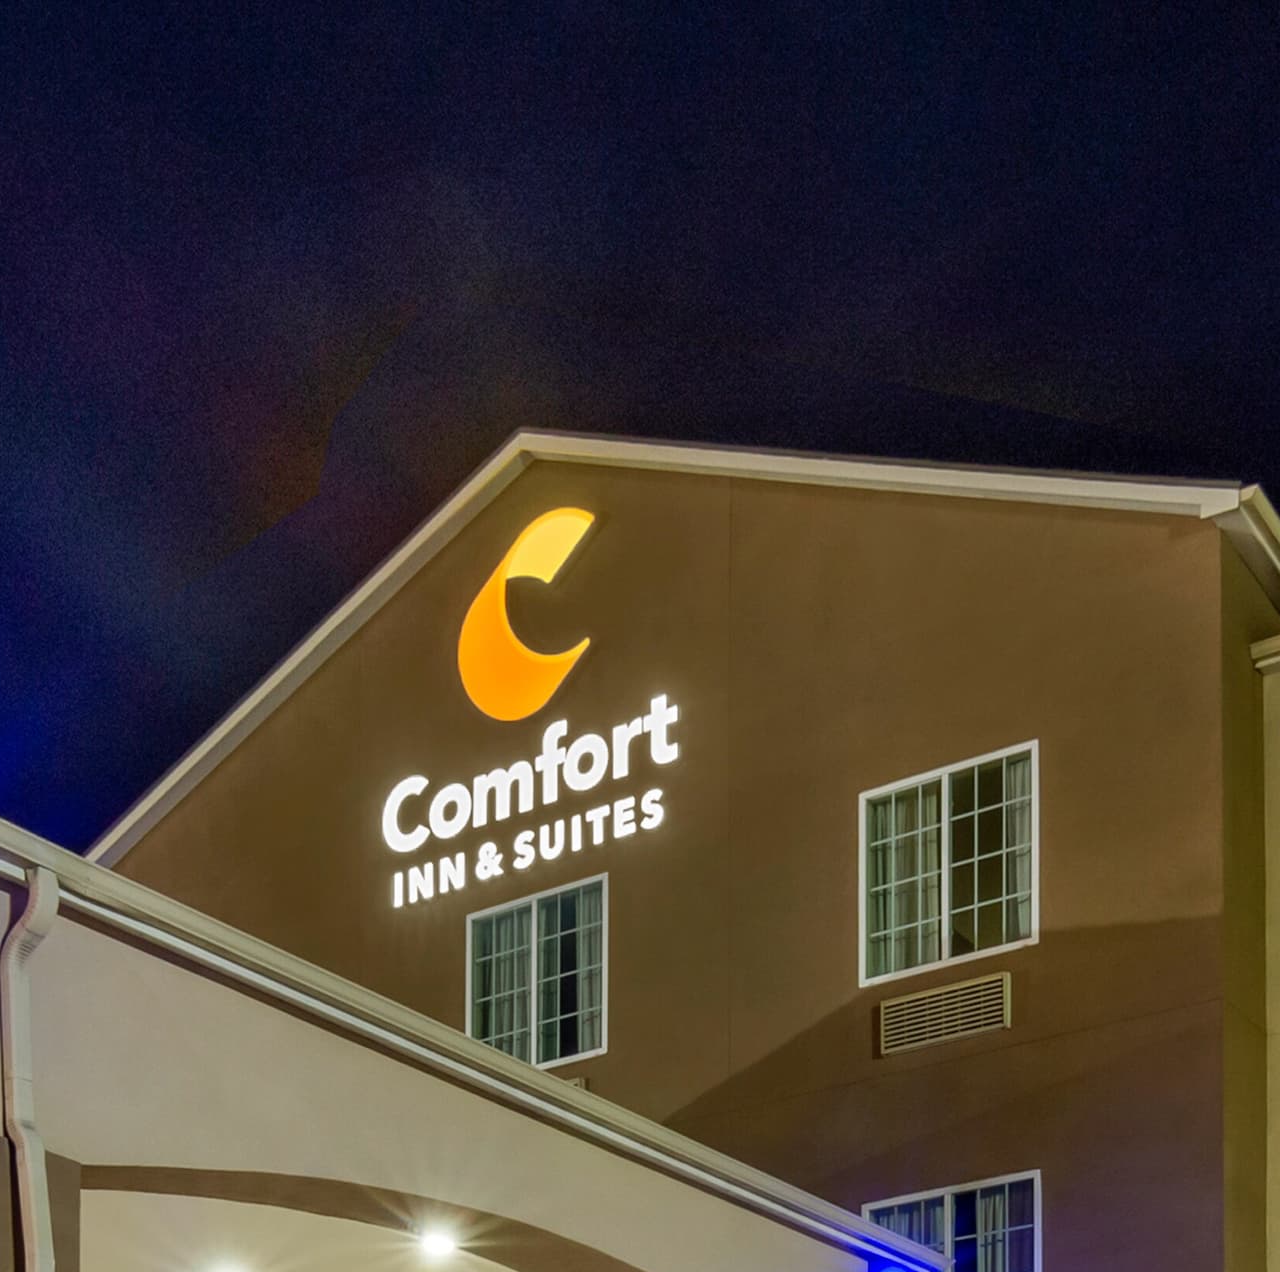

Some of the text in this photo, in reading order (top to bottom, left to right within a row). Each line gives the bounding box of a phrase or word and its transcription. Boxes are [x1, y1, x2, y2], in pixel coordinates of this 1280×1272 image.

[381, 694, 679, 853] Comfort
[392, 788, 666, 909] INN & SUITES
